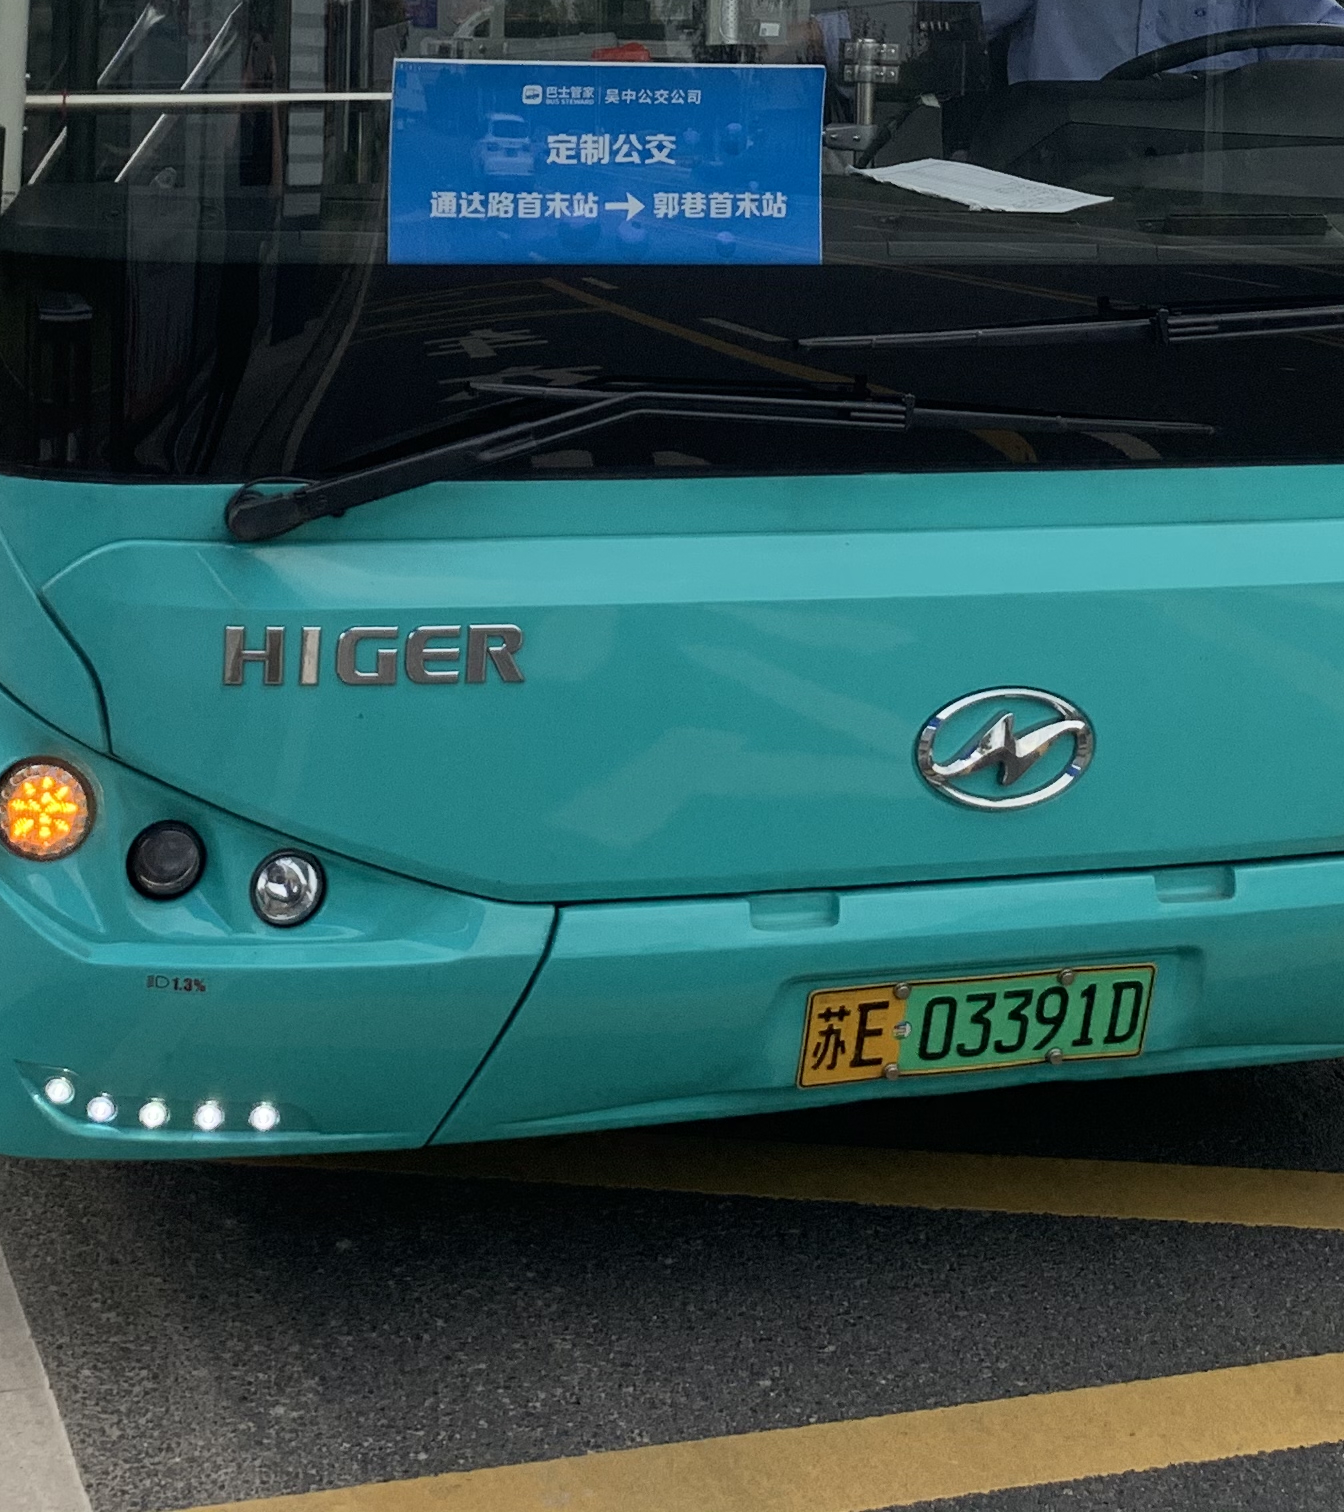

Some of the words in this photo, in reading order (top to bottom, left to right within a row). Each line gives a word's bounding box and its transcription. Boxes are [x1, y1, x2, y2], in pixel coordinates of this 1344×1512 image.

[546, 86, 595, 99] 巴士管家
[604, 88, 702, 105] 吴中公交公司
[546, 133, 677, 166] 定制公交
[429, 190, 599, 219] 通达路首末站
[653, 190, 788, 219] 郭巷首末站
[222, 623, 525, 687] HIGER
